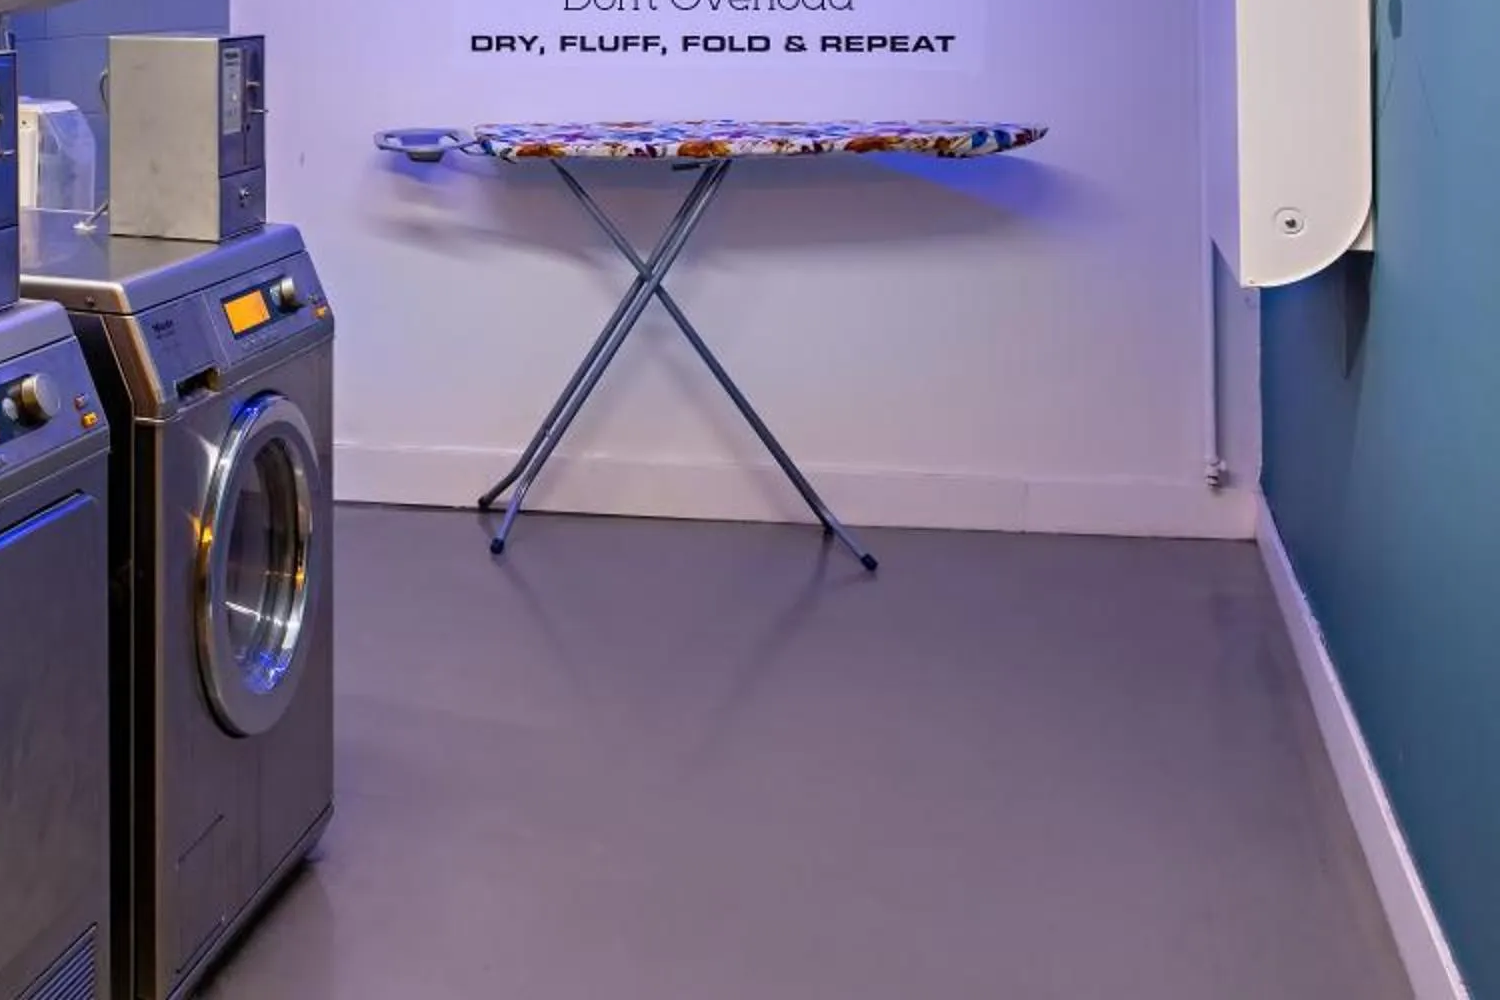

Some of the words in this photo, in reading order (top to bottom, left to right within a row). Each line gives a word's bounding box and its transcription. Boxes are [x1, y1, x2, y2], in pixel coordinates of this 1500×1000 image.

[471, 35, 544, 55] DRY,
[560, 35, 667, 56] FLUFF,
[682, 35, 770, 52] FOLD
[784, 36, 808, 52] &
[820, 36, 955, 52] REPEAT
